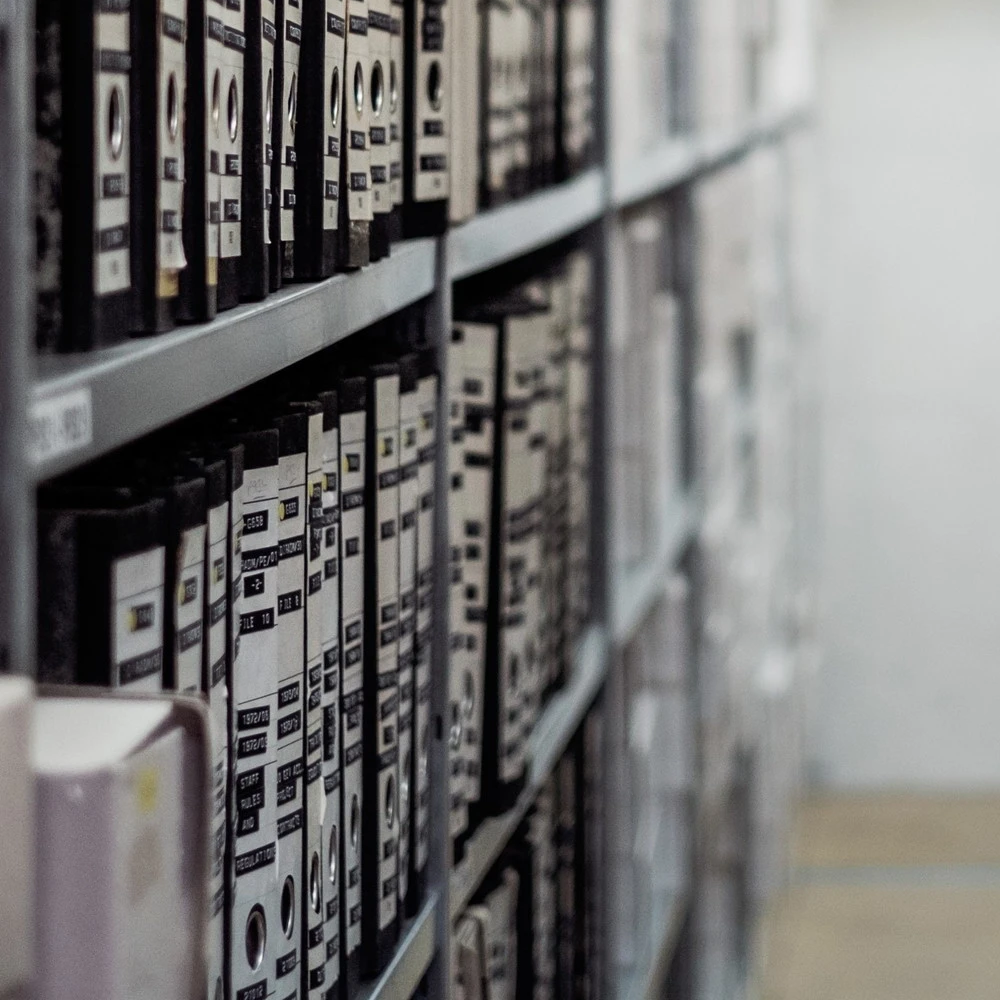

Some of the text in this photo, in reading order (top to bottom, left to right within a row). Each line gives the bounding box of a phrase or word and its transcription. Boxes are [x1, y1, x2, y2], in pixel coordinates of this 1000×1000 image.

[240, 773, 260, 790] STAFF
[240, 793, 261, 809] RULES
[242, 816, 255, 831] AND
